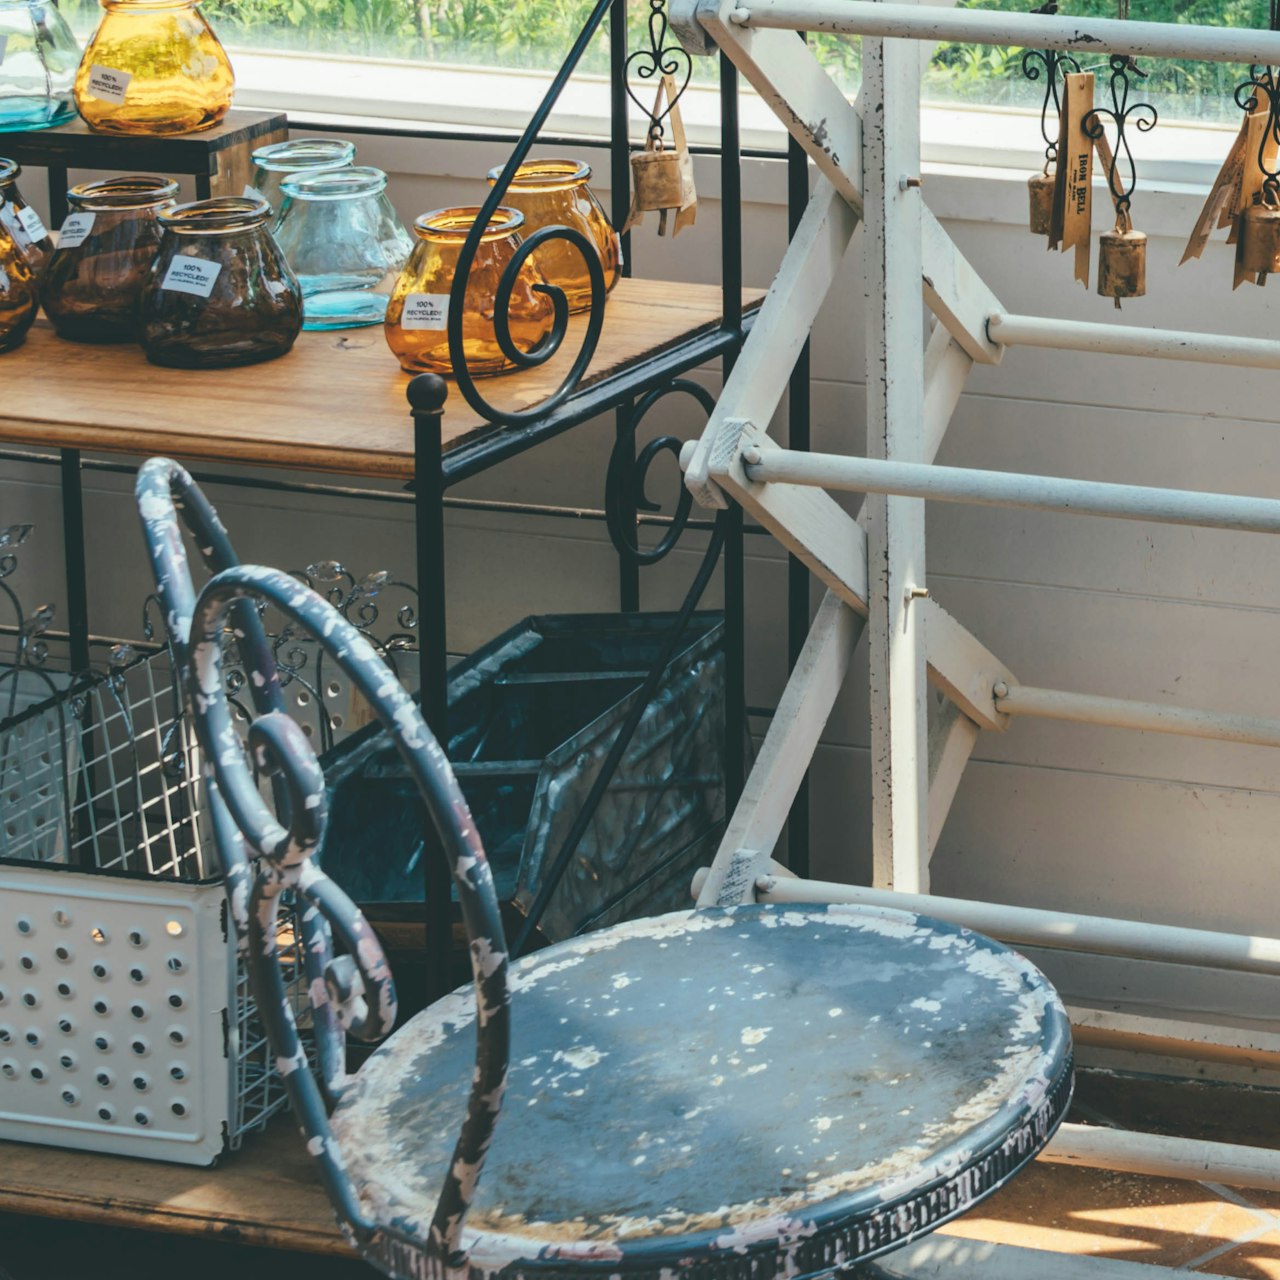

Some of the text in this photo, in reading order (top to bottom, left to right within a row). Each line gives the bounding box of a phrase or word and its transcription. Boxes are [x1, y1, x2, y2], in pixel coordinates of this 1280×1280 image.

[1076, 153, 1089, 215] IRON BELL
[183, 264, 202, 272] 100%
